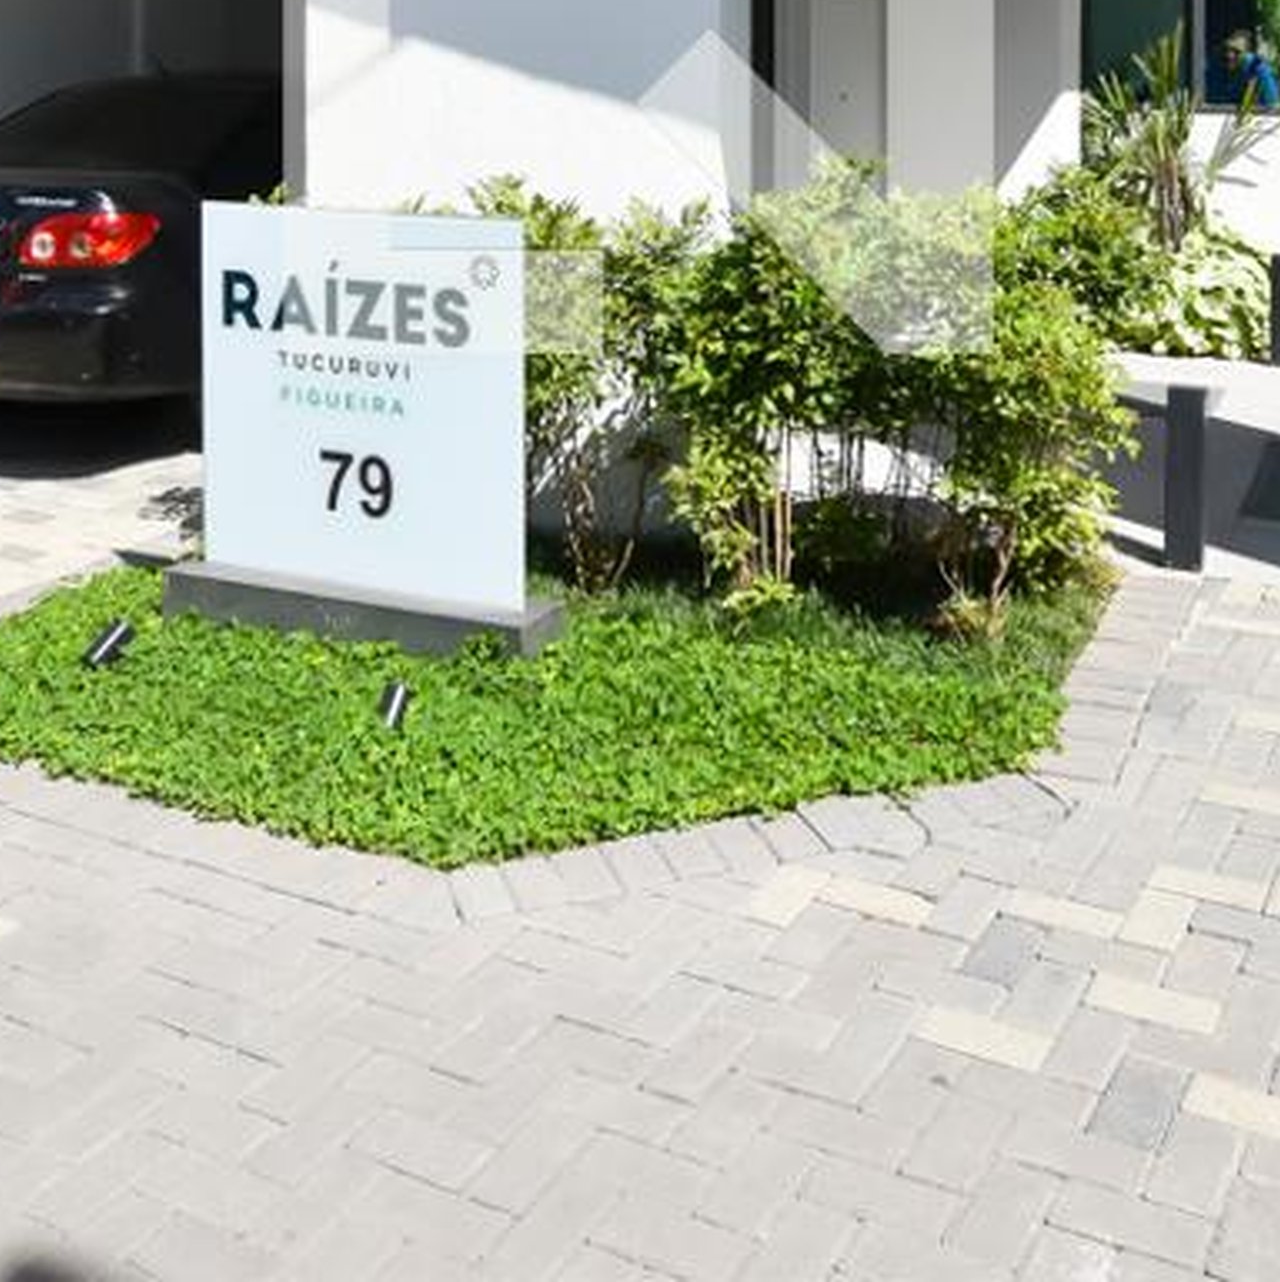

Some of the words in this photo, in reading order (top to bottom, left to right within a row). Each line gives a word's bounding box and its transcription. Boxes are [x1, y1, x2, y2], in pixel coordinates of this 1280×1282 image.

[222, 260, 470, 348] RAÍZES
[277, 350, 412, 382] TUCURUVI
[320, 449, 394, 519] 79
